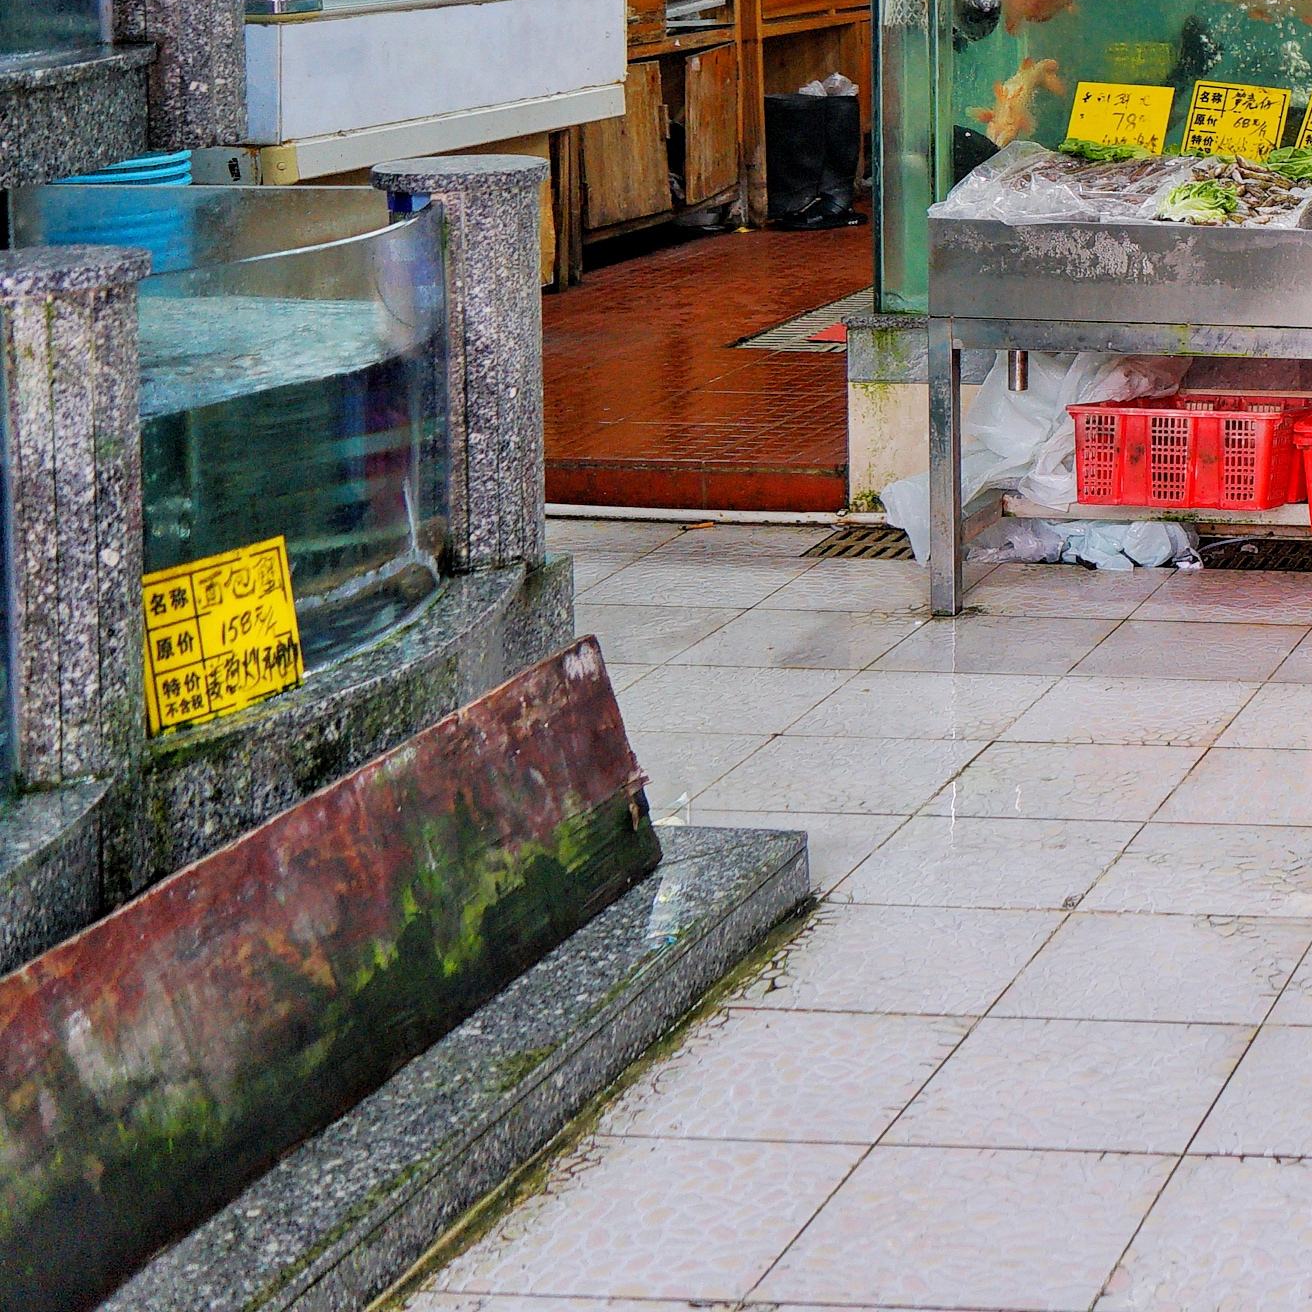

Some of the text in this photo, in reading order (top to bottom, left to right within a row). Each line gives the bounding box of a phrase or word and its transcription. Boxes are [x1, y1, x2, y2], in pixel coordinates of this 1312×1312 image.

[1199, 90, 1223, 104] 名称
[1194, 114, 1217, 126] 原价
[1191, 135, 1215, 147] 特价
[149, 555, 286, 617] 名称 面包蟹
[155, 631, 195, 661] 原价
[162, 671, 202, 700] 特价
[165, 694, 205, 719] 不含税
